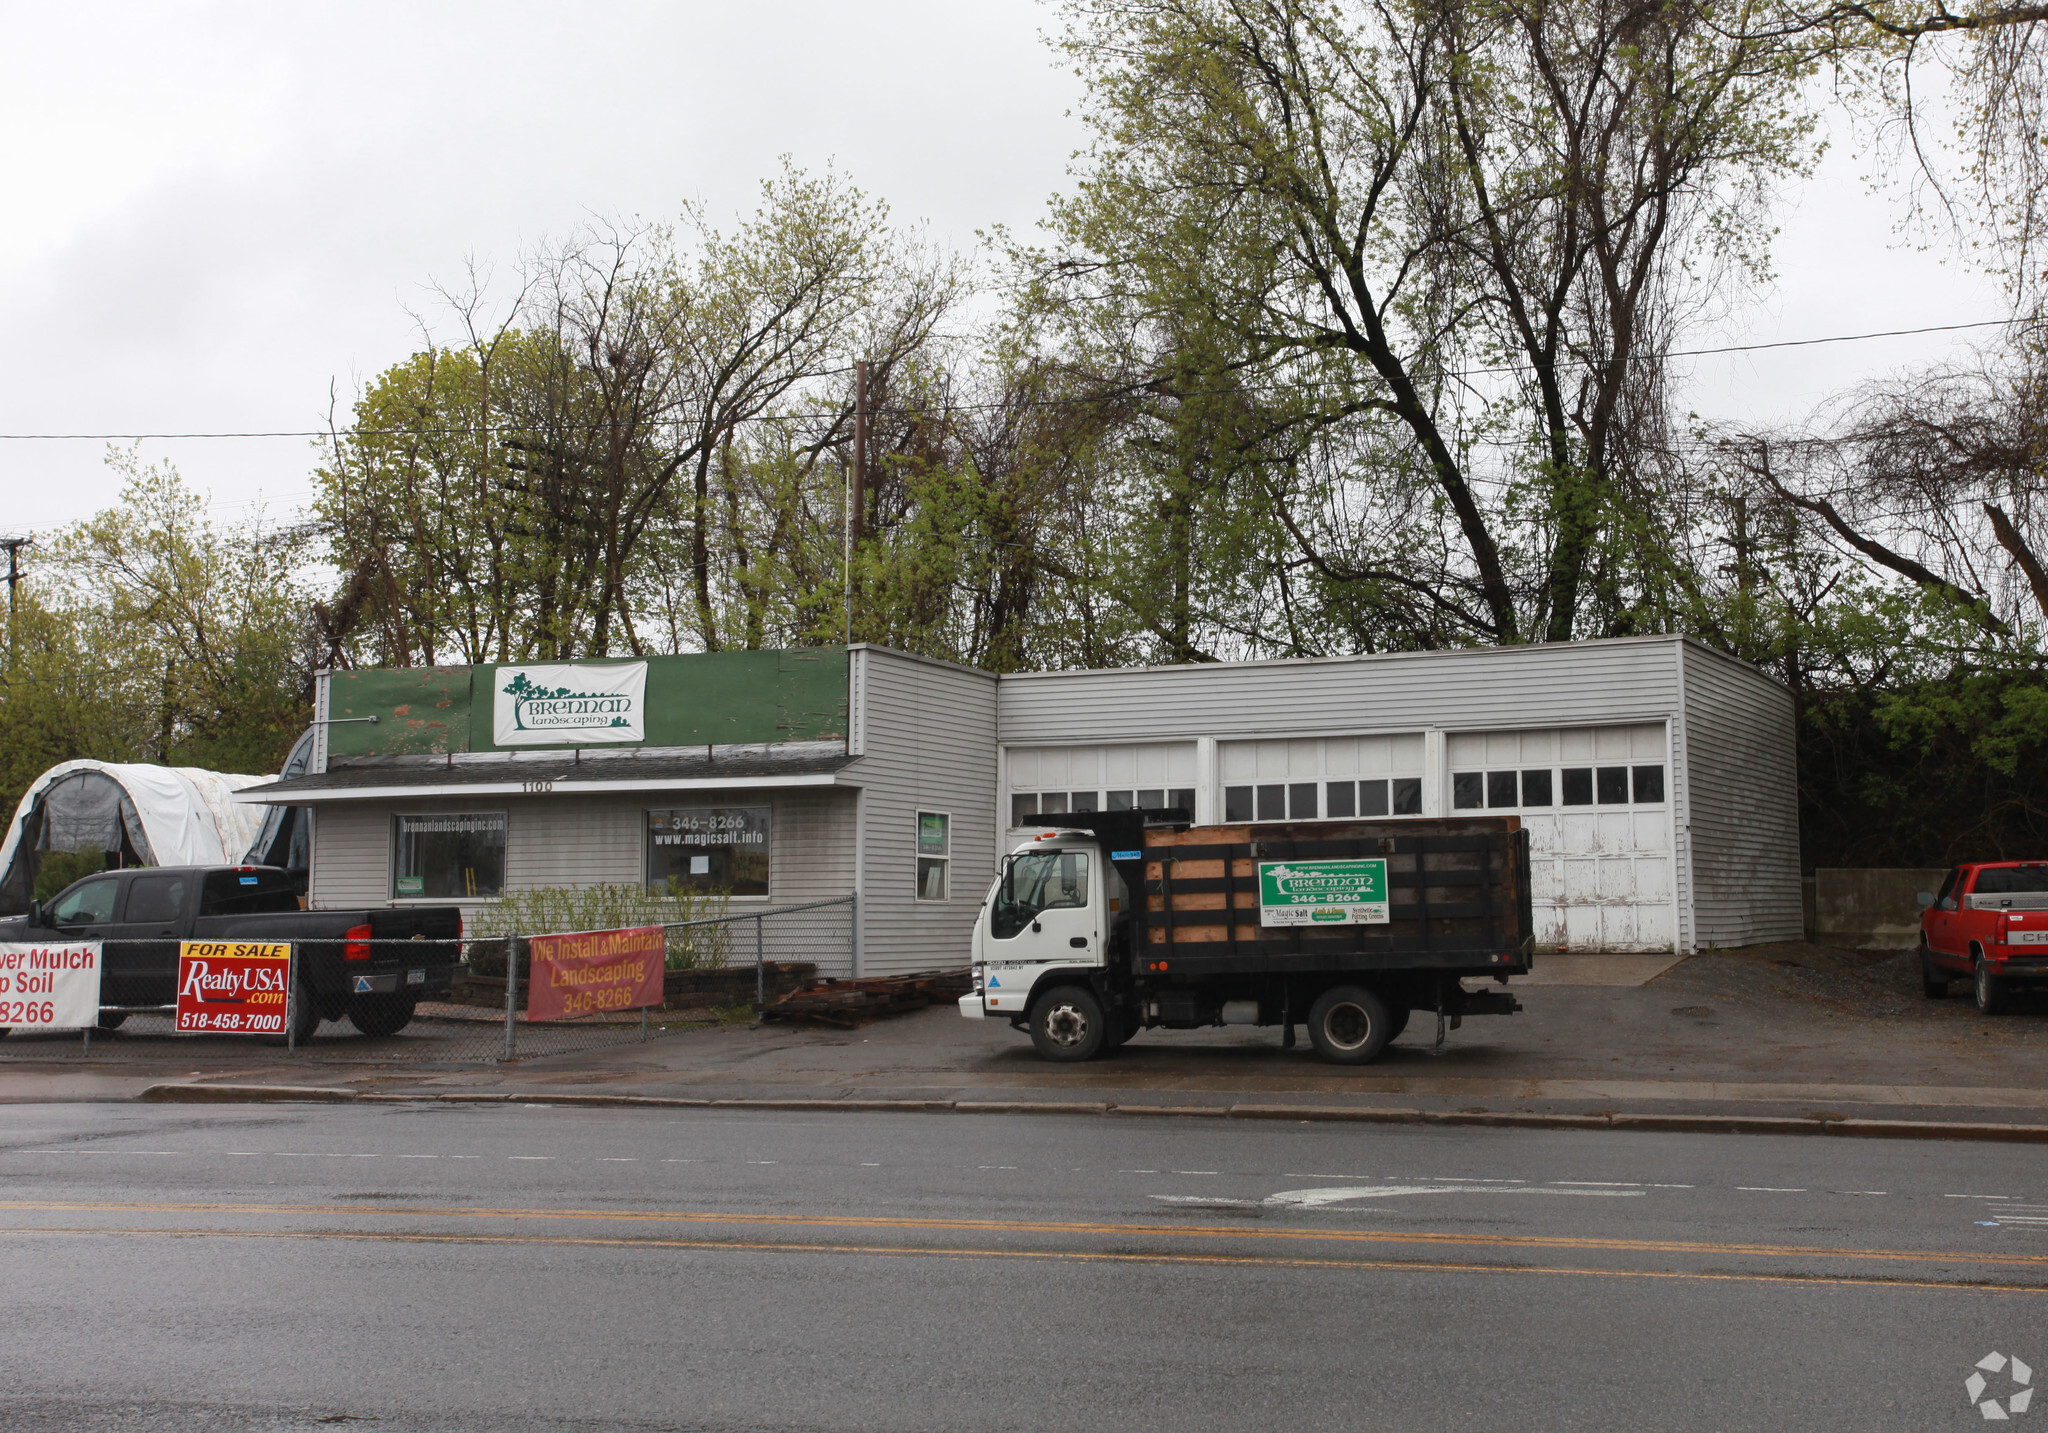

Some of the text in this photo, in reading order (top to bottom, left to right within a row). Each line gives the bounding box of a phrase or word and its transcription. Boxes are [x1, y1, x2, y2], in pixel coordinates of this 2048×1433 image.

[531, 716, 608, 726] landscaping
[522, 781, 553, 793] 1100
[403, 818, 504, 833] brennanlandscapinginc.com
[672, 816, 745, 830] 346-8266
[655, 831, 763, 846] www.magicsalt.info
[1291, 894, 1361, 903] 346-8266
[1275, 909, 1295, 919] Magic
[1295, 908, 1308, 918] Salt
[187, 944, 284, 957] FOR SALE
[533, 930, 663, 961] We Install & Maintain
[30, 948, 94, 969] Mulch
[551, 960, 645, 987] Landscaping
[16, 971, 54, 993] Soil
[246, 992, 284, 1004] .com
[563, 986, 632, 1013] 346-8266
[0, 1001, 54, 1023] 8266
[181, 1013, 282, 1030] 518-458-7000
